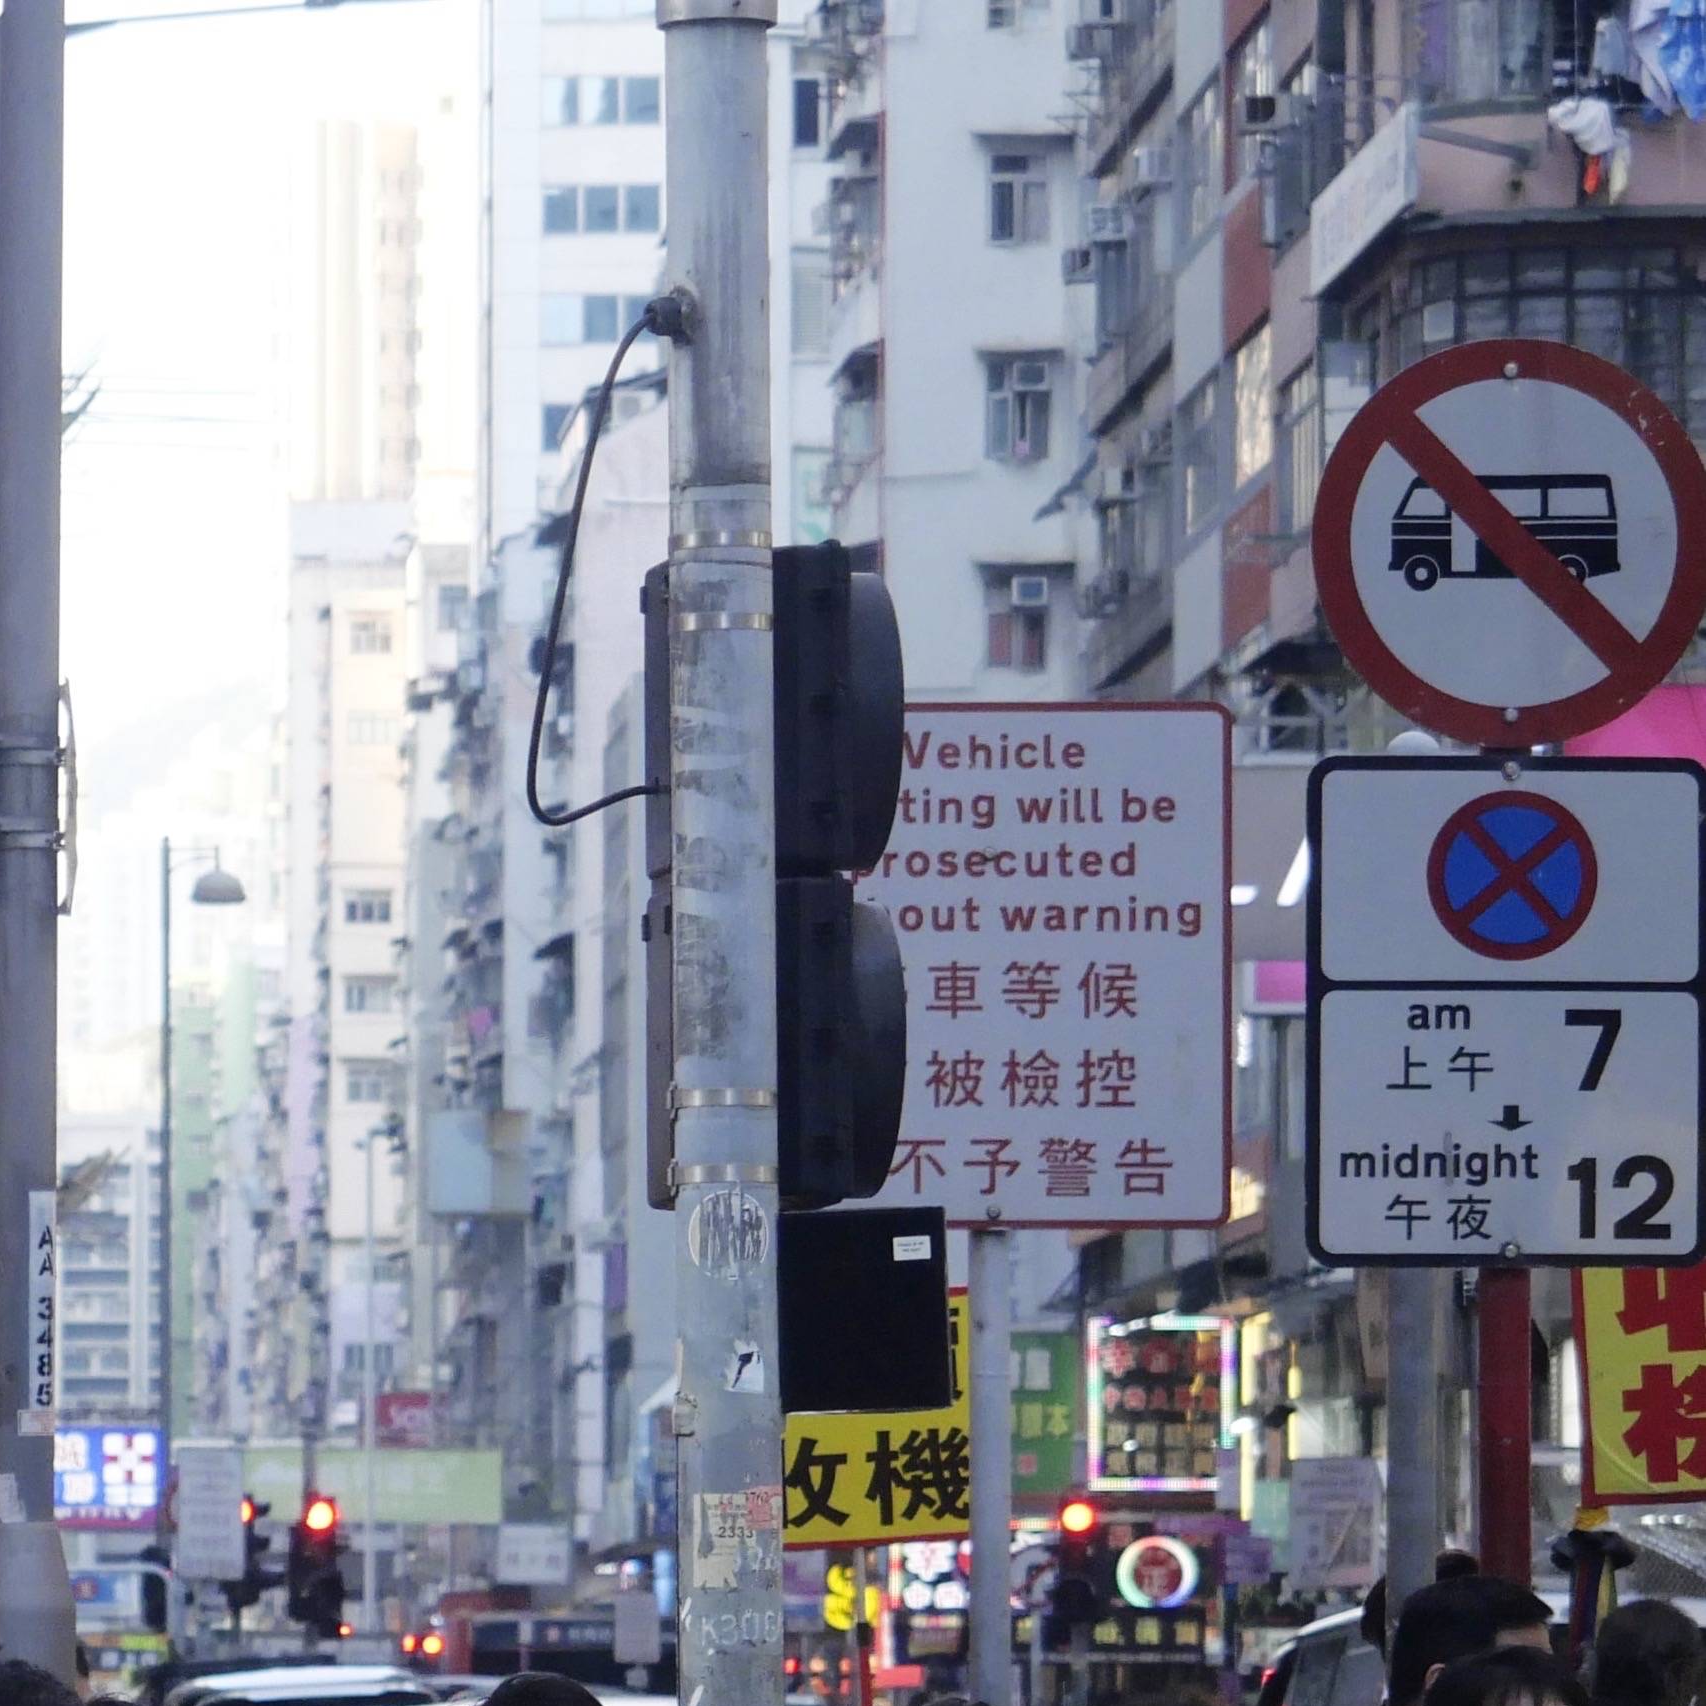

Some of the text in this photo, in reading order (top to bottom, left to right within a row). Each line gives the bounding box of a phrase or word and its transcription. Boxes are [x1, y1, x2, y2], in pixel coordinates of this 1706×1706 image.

[902, 730, 1087, 769] Vehicle
[900, 788, 1177, 830] ting will be
[1000, 896, 1203, 937] warning
[925, 961, 1139, 1020] 車等候
[1386, 1045, 1495, 1092] 上午
[1407, 1002, 1622, 1092] am 7
[925, 1049, 1138, 1109] 被檢控
[889, 1138, 1175, 1198] 不予警告
[1339, 1142, 1675, 1240] midnight 12
[1385, 1193, 1493, 1241] 午夜
